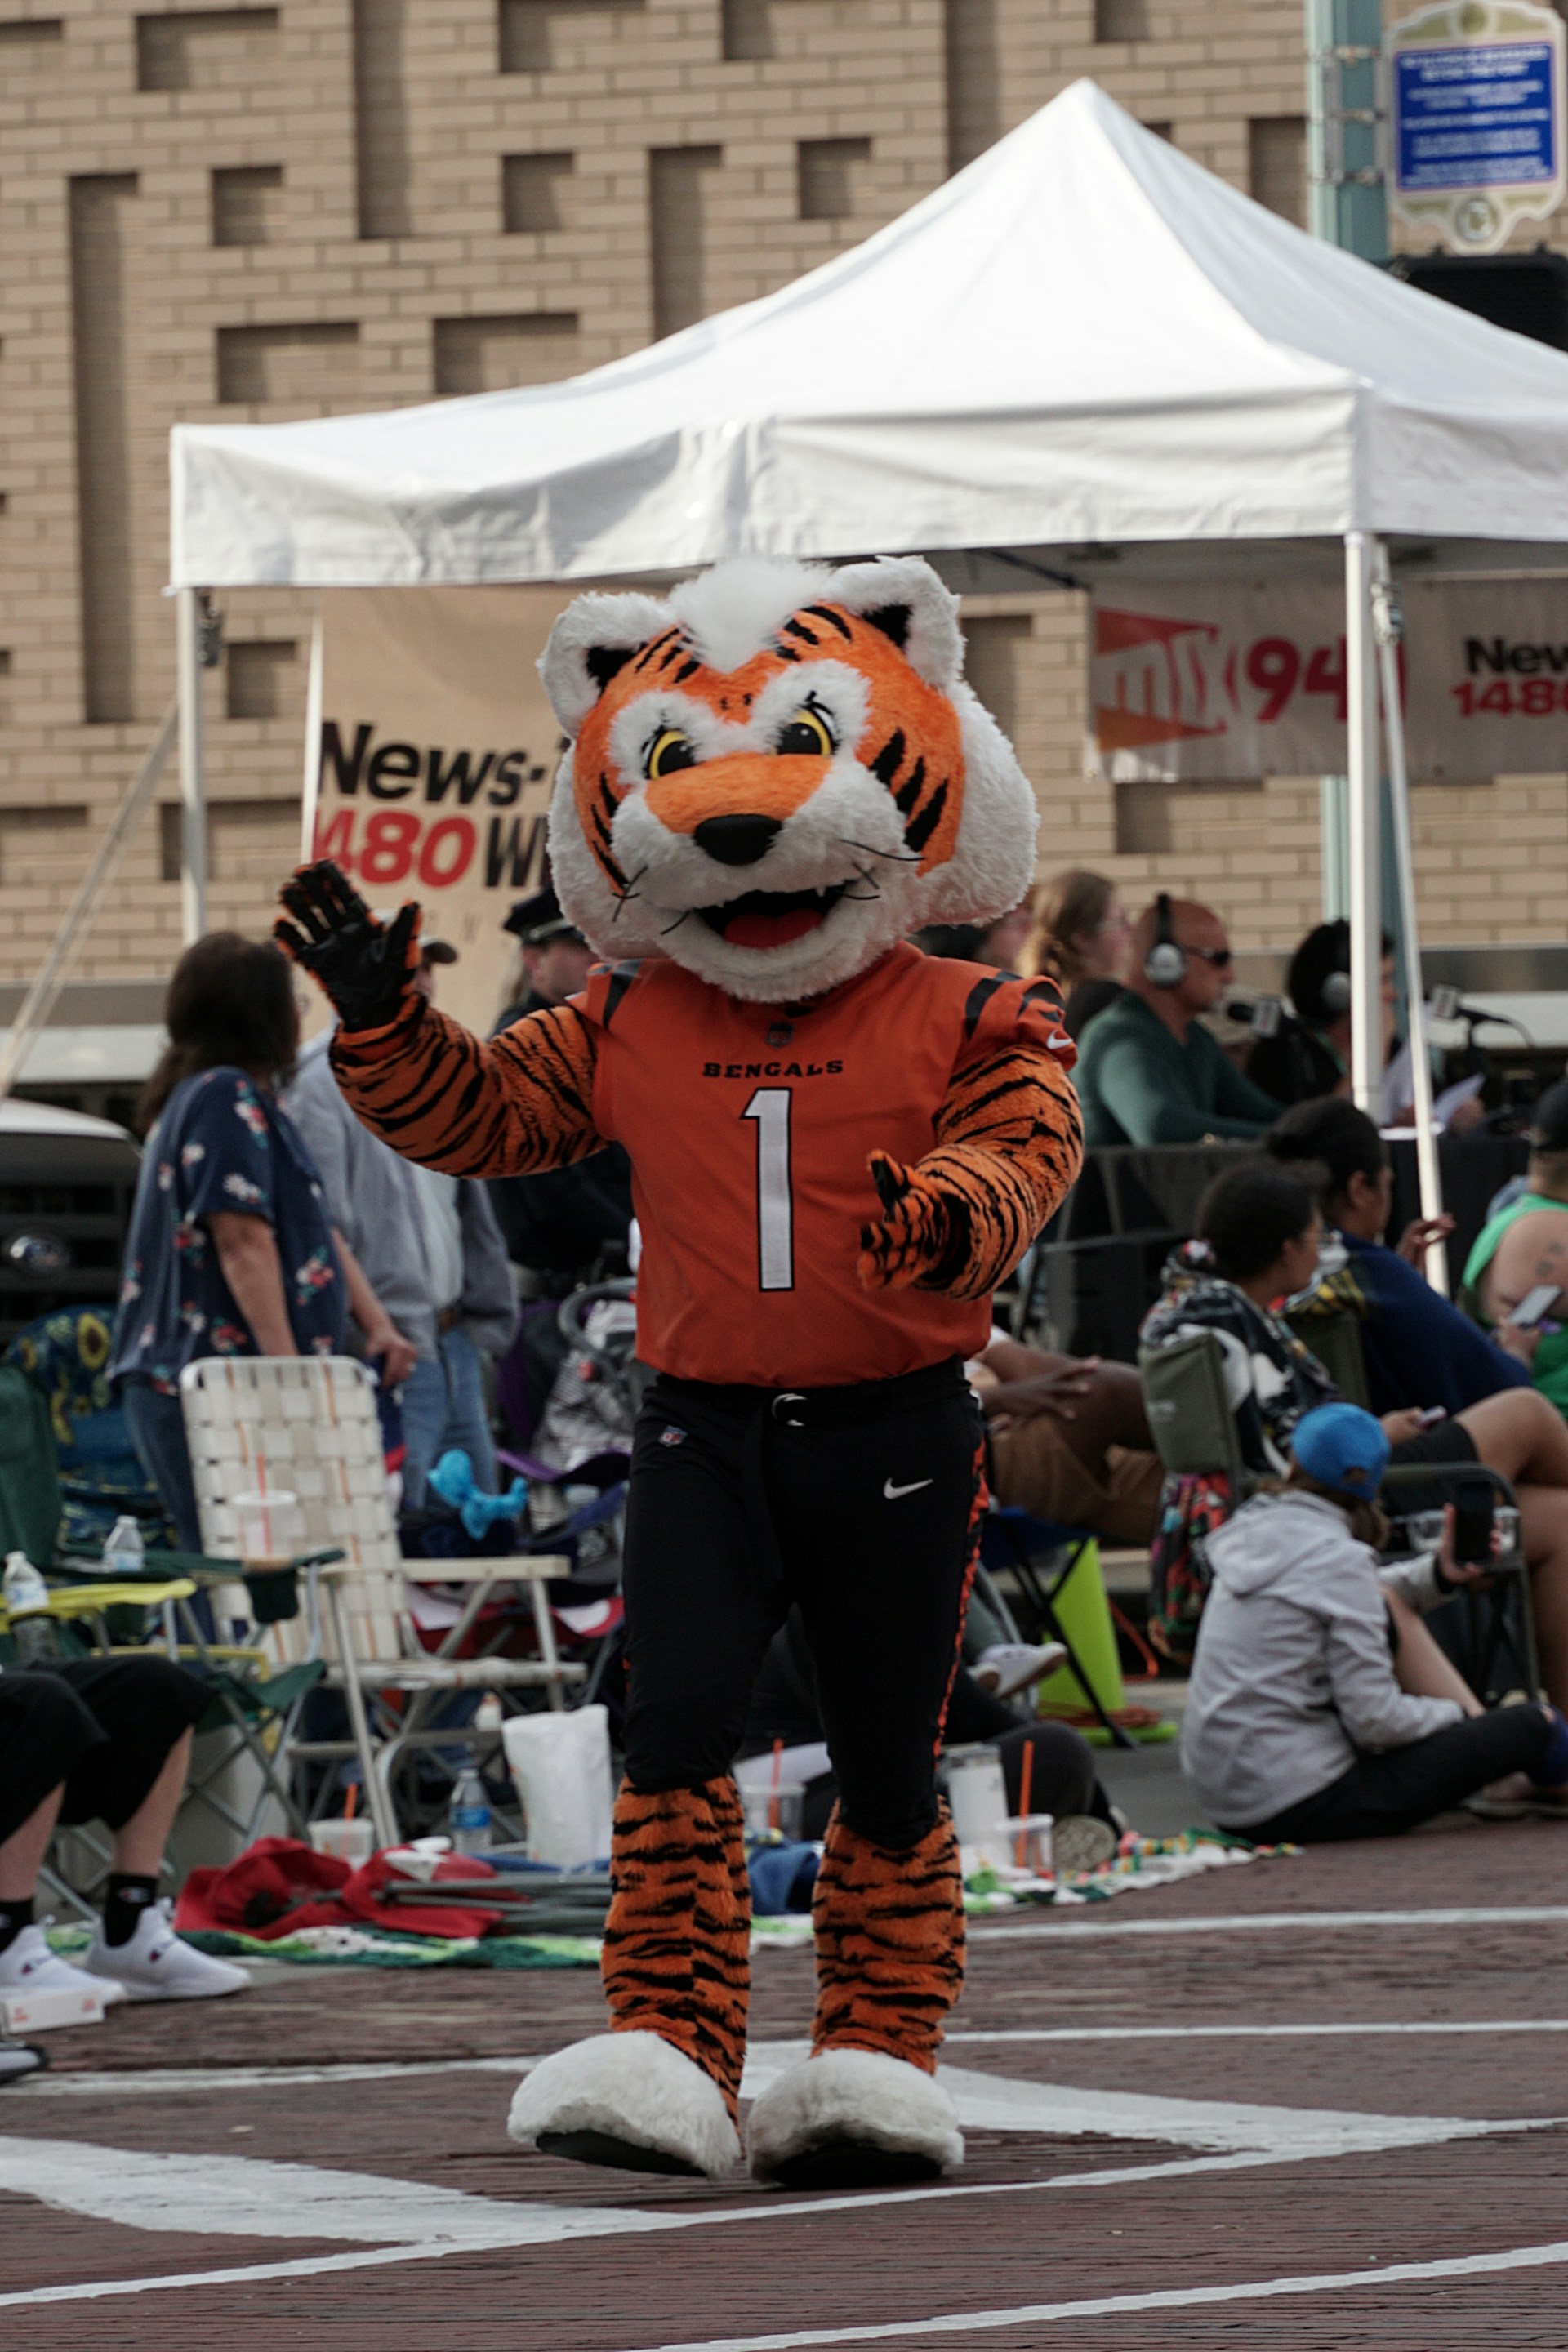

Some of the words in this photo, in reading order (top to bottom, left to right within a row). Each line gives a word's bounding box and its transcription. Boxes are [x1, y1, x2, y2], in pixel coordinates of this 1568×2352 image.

[1245, 635, 1405, 724] 94
[1451, 679, 1568, 718] 148
[320, 720, 571, 806] News-
[312, 809, 477, 888] 480
[702, 1060, 844, 1079] BENGALS
[740, 1086, 795, 1292] 1
